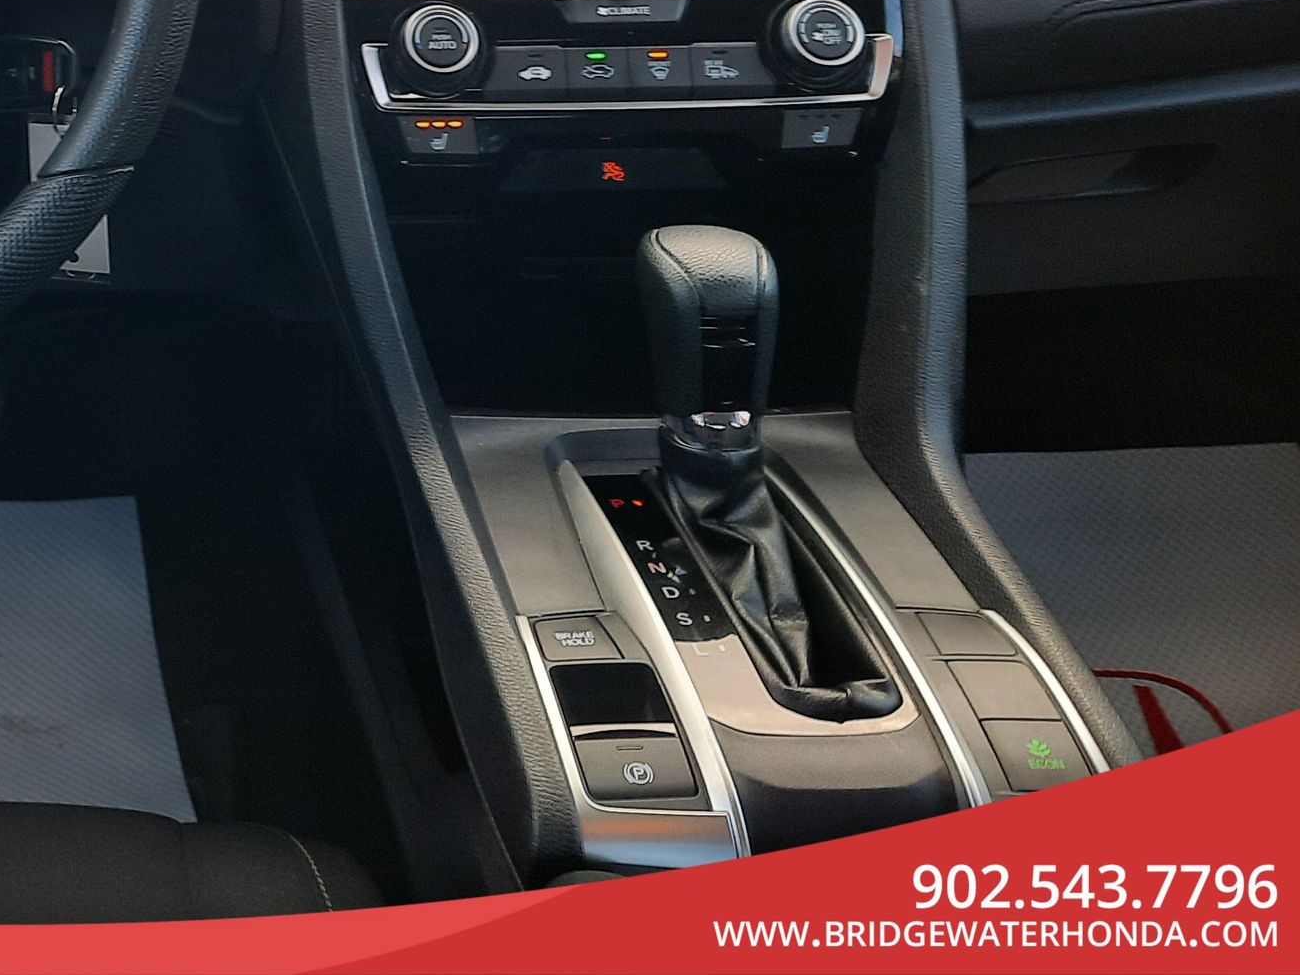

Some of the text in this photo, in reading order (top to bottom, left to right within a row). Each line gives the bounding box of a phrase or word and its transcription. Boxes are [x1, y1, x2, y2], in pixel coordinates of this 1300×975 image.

[608, 6, 651, 16] CLIMATE
[428, 40, 457, 50] AUTO
[609, 498, 625, 509] P
[636, 539, 654, 552] R
[647, 562, 667, 574] N
[661, 585, 681, 599] D
[675, 612, 693, 627] S
[555, 630, 596, 641] BRAKE
[561, 637, 596, 647] HOLD
